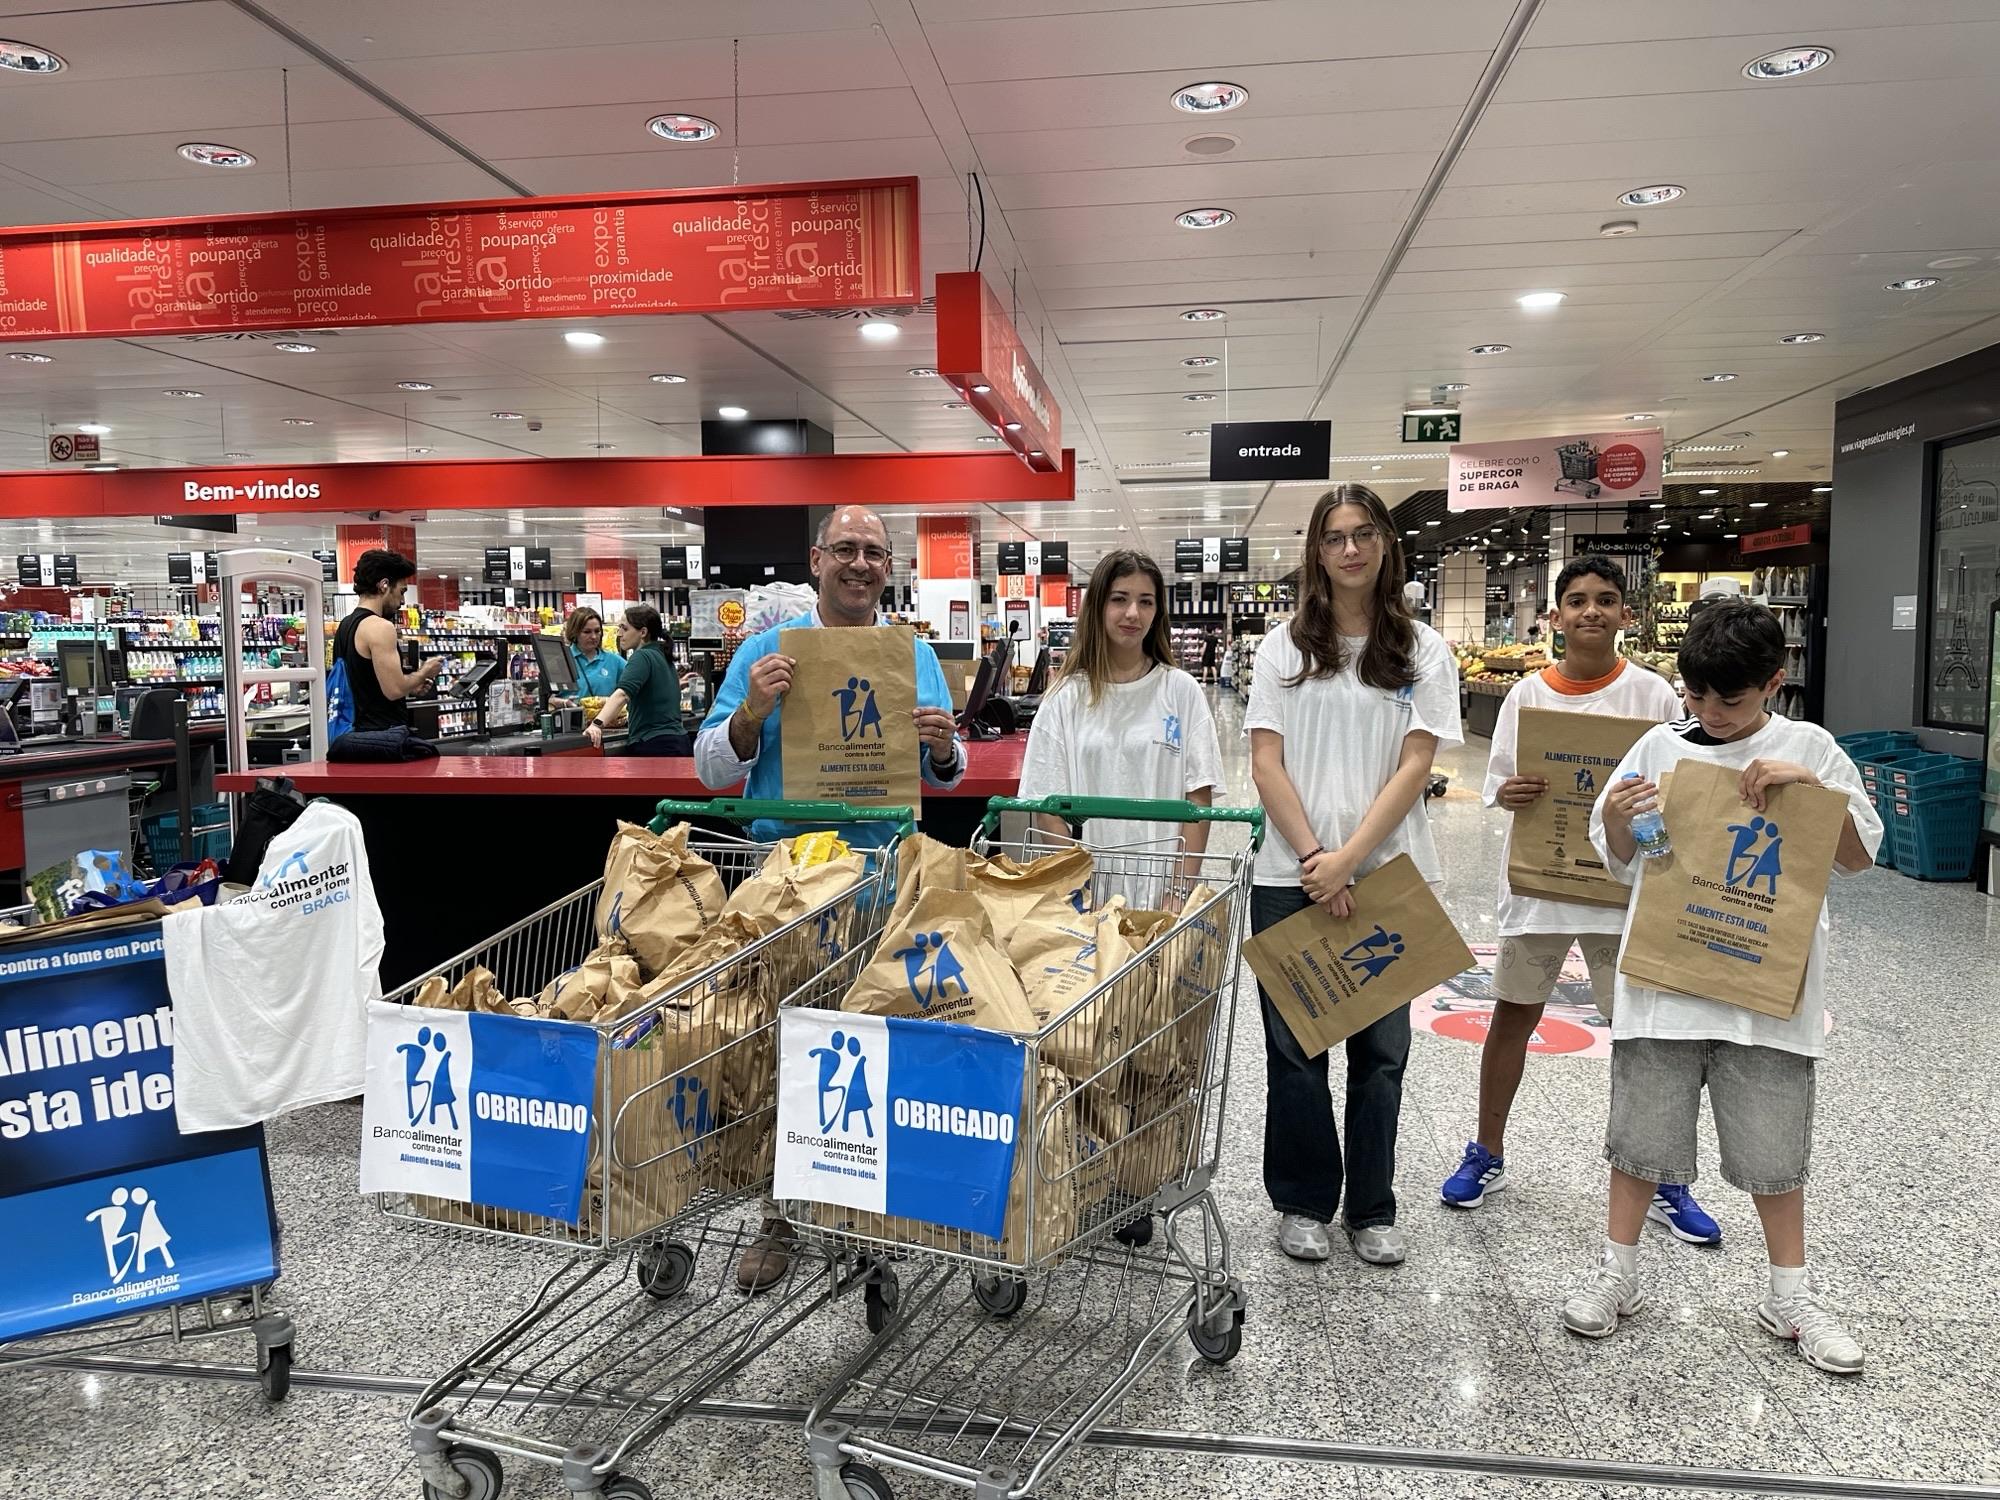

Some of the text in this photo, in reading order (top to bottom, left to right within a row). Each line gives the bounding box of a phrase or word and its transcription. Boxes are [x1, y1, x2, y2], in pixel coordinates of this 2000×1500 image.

[819, 202, 858, 215] serviço
[507, 219, 543, 230] serviço
[547, 223, 575, 234] oferta
[672, 216, 752, 237] qualidade
[214, 235, 249, 247] serviço
[251, 239, 279, 251] oferta
[370, 232, 445, 252] qualidade
[480, 232, 557, 251] poupança
[613, 208, 629, 266] garantia
[726, 234, 754, 245] preço
[845, 230, 857, 260] preço
[86, 248, 157, 267] qualidade
[189, 248, 262, 267] poupança
[314, 224, 331, 280] garantia
[420, 249, 447, 260] preço
[532, 244, 542, 274] preço
[134, 263, 158, 275] preço
[238, 260, 249, 288] preço
[589, 268, 674, 288] proximidade
[498, 274, 552, 291] sortido
[749, 272, 802, 289] garantia
[207, 288, 259, 305] sortido
[293, 283, 372, 301] proximidade
[441, 285, 493, 303] garantia
[537, 293, 587, 303] atendimento
[593, 286, 637, 304] preço
[155, 299, 202, 316] garantia
[244, 306, 292, 317] atendimento
[297, 300, 338, 317] preço
[1840, 422, 1915, 454] www.viagenselcorteingles.pt
[1238, 444, 1301, 459] entrada
[1460, 455, 1540, 469] CELEBRE COM O
[1459, 468, 1523, 480] SUPERCOR
[183, 478, 321, 502] Bem-vindos
[1459, 481, 1519, 492] DE BRAGA
[512, 561, 524, 570] 16
[689, 560, 700, 569] 17
[1027, 556, 1039, 566] 19
[1204, 553, 1219, 563] 20
[43, 567, 53, 577] 13
[193, 565, 204, 575] 14
[818, 742, 886, 751] Bancoalimentar
[1544, 751, 1582, 764] ALIMENTE
[1583, 755, 1601, 766] ESTA
[820, 763, 851, 773] ALIMENTE
[852, 763, 868, 772] ESTA
[270, 876, 350, 910] contra a fome
[1691, 874, 1777, 907] Bancoalimentar
[302, 889, 351, 915] BRAGA
[1721, 895, 1746, 907] contra
[1753, 903, 1774, 914] fome
[1685, 903, 1769, 935] ALIMENTE ESTA IDEIA.
[0, 938, 165, 976] contra a fome em Port
[1319, 936, 1359, 994] Bancoalimentar
[1302, 949, 1323, 977] ALIMENTE
[1319, 974, 1331, 992] ESTA
[957, 1008, 976, 1018] fome
[474, 1090, 588, 1135] OBRIGADO
[893, 1097, 1015, 1145] OBRIGADO
[373, 1126, 463, 1148] Bancoalimentar
[787, 1131, 878, 1157] Bancoalimentar
[412, 1142, 463, 1157] contra a fome
[823, 1149, 878, 1166] contra a fome
[400, 1153, 463, 1171] Alimente esta ideia.
[811, 1160, 878, 1181] Alimente esta ideia.
[72, 1273, 181, 1305] Bancoalimentar
[115, 1283, 181, 1304] contra a fome
